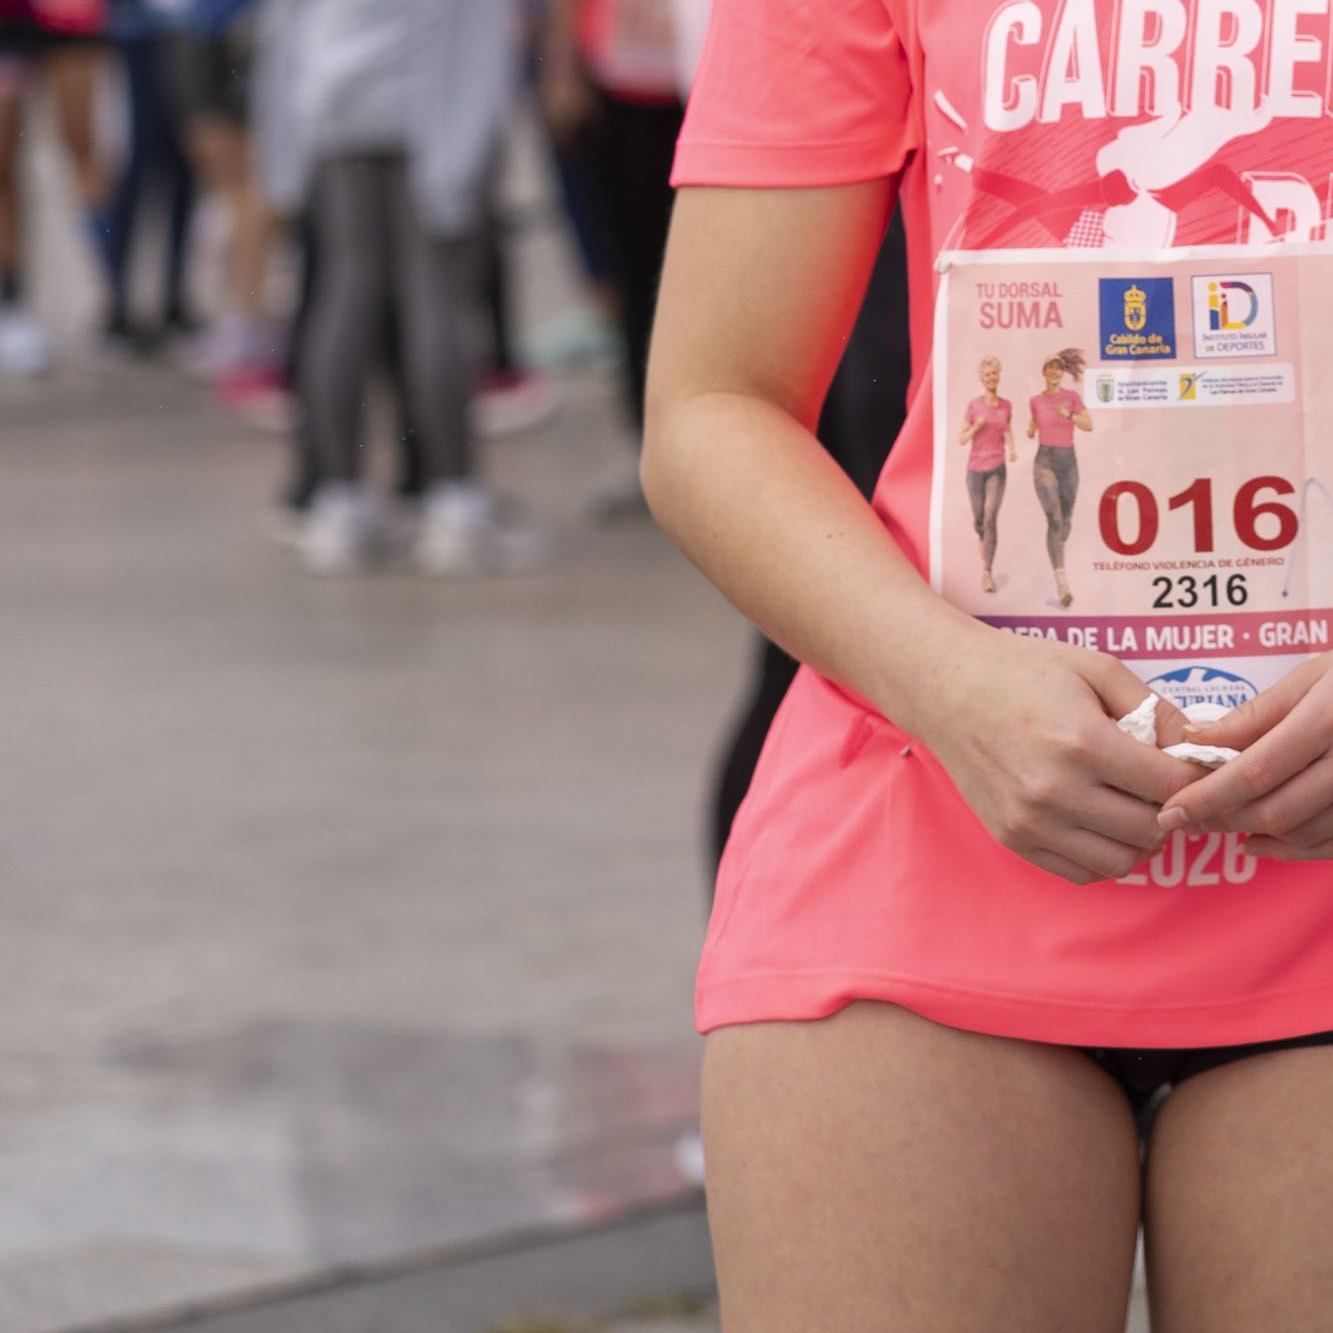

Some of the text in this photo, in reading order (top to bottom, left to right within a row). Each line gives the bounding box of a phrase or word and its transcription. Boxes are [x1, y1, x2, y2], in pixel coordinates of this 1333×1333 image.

[975, 281, 1063, 299] TU DORSAL
[979, 301, 1064, 329] SUMA
[1148, 333, 1163, 345] de
[1216, 342, 1265, 353] DEPORTES
[1098, 475, 1299, 556] 016
[1152, 559, 1216, 570] VIOLENCIA
[1218, 558, 1234, 568] DE
[1152, 573, 1248, 608] 2316
[1067, 626, 1099, 650] DE
[1106, 626, 1138, 651] LA
[1146, 623, 1235, 652] MUJER
[1258, 619, 1329, 647] GRAN
[1115, 829, 1258, 887] 026
